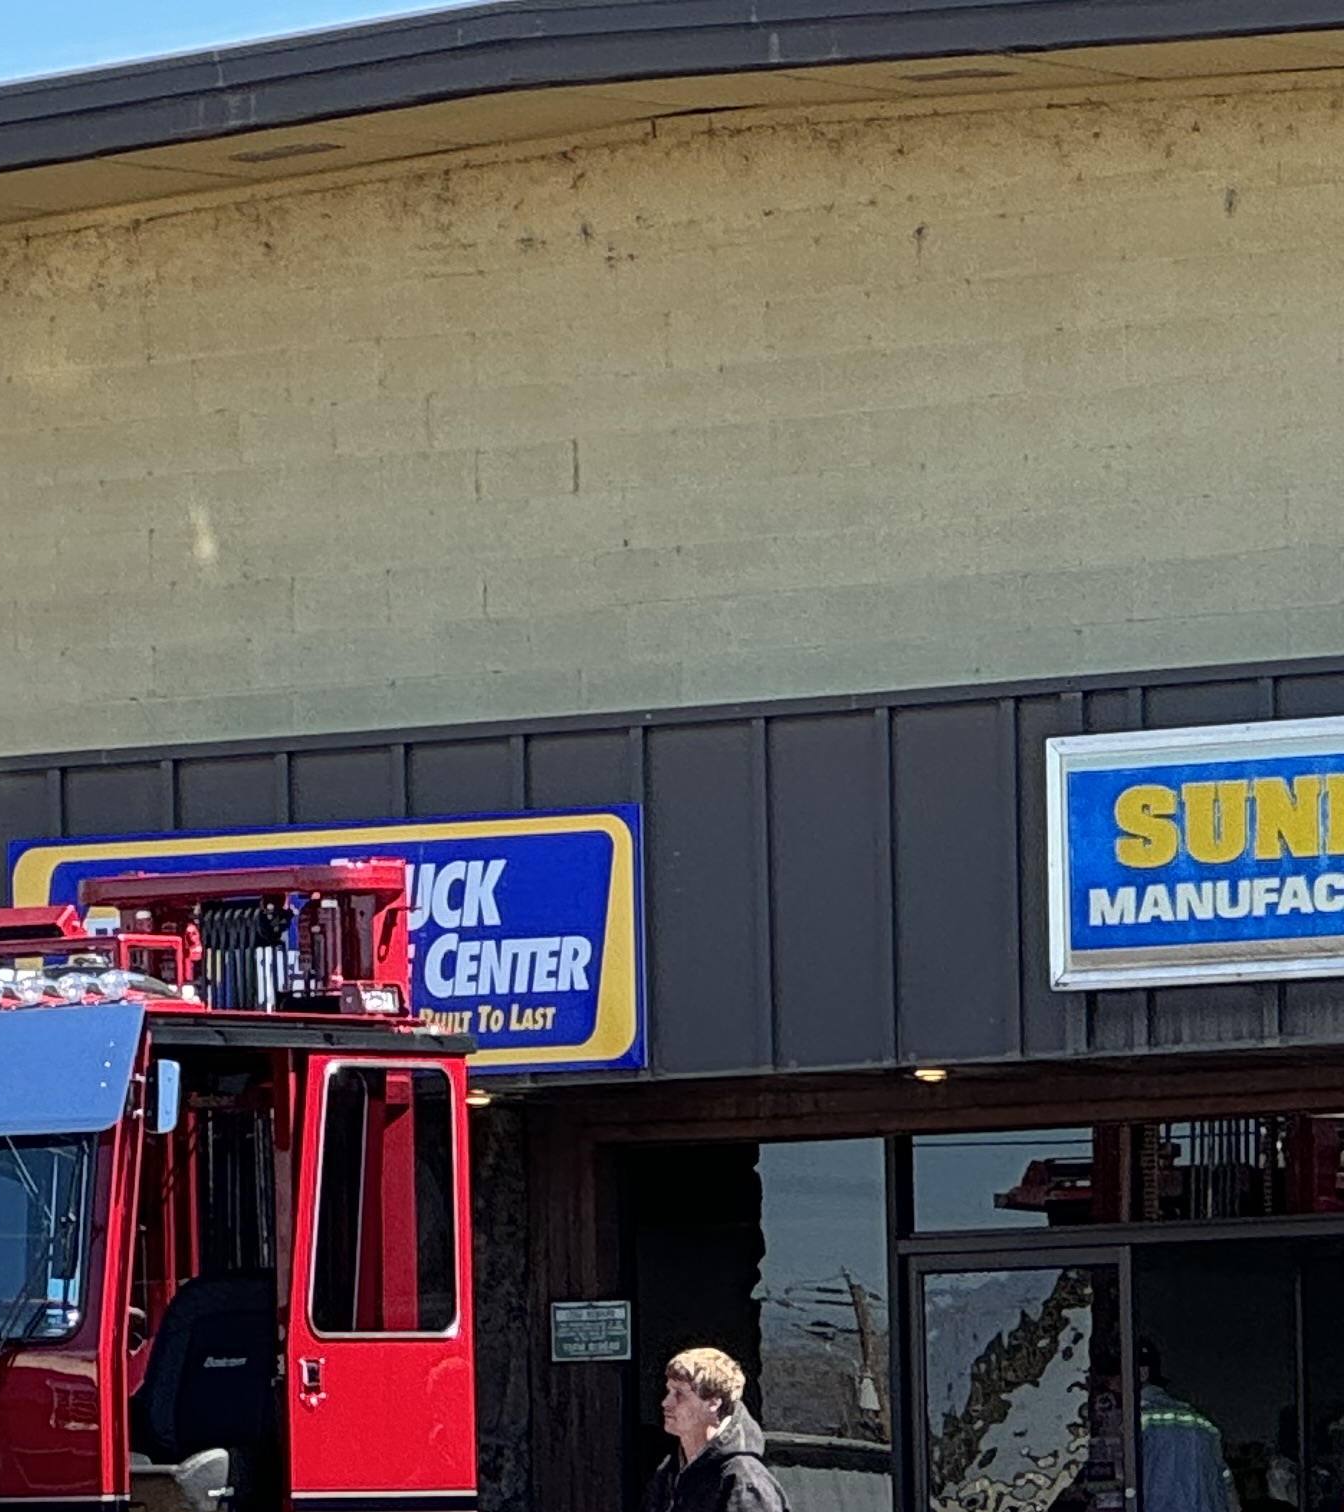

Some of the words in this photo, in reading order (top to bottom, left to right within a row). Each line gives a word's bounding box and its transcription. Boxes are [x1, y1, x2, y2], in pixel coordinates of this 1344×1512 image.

[1115, 773, 1344, 868] SUN
[405, 859, 507, 931] UCK
[1089, 873, 1344, 926] MANUFAC
[424, 933, 592, 998] CENTER
[509, 1003, 556, 1031] LAST
